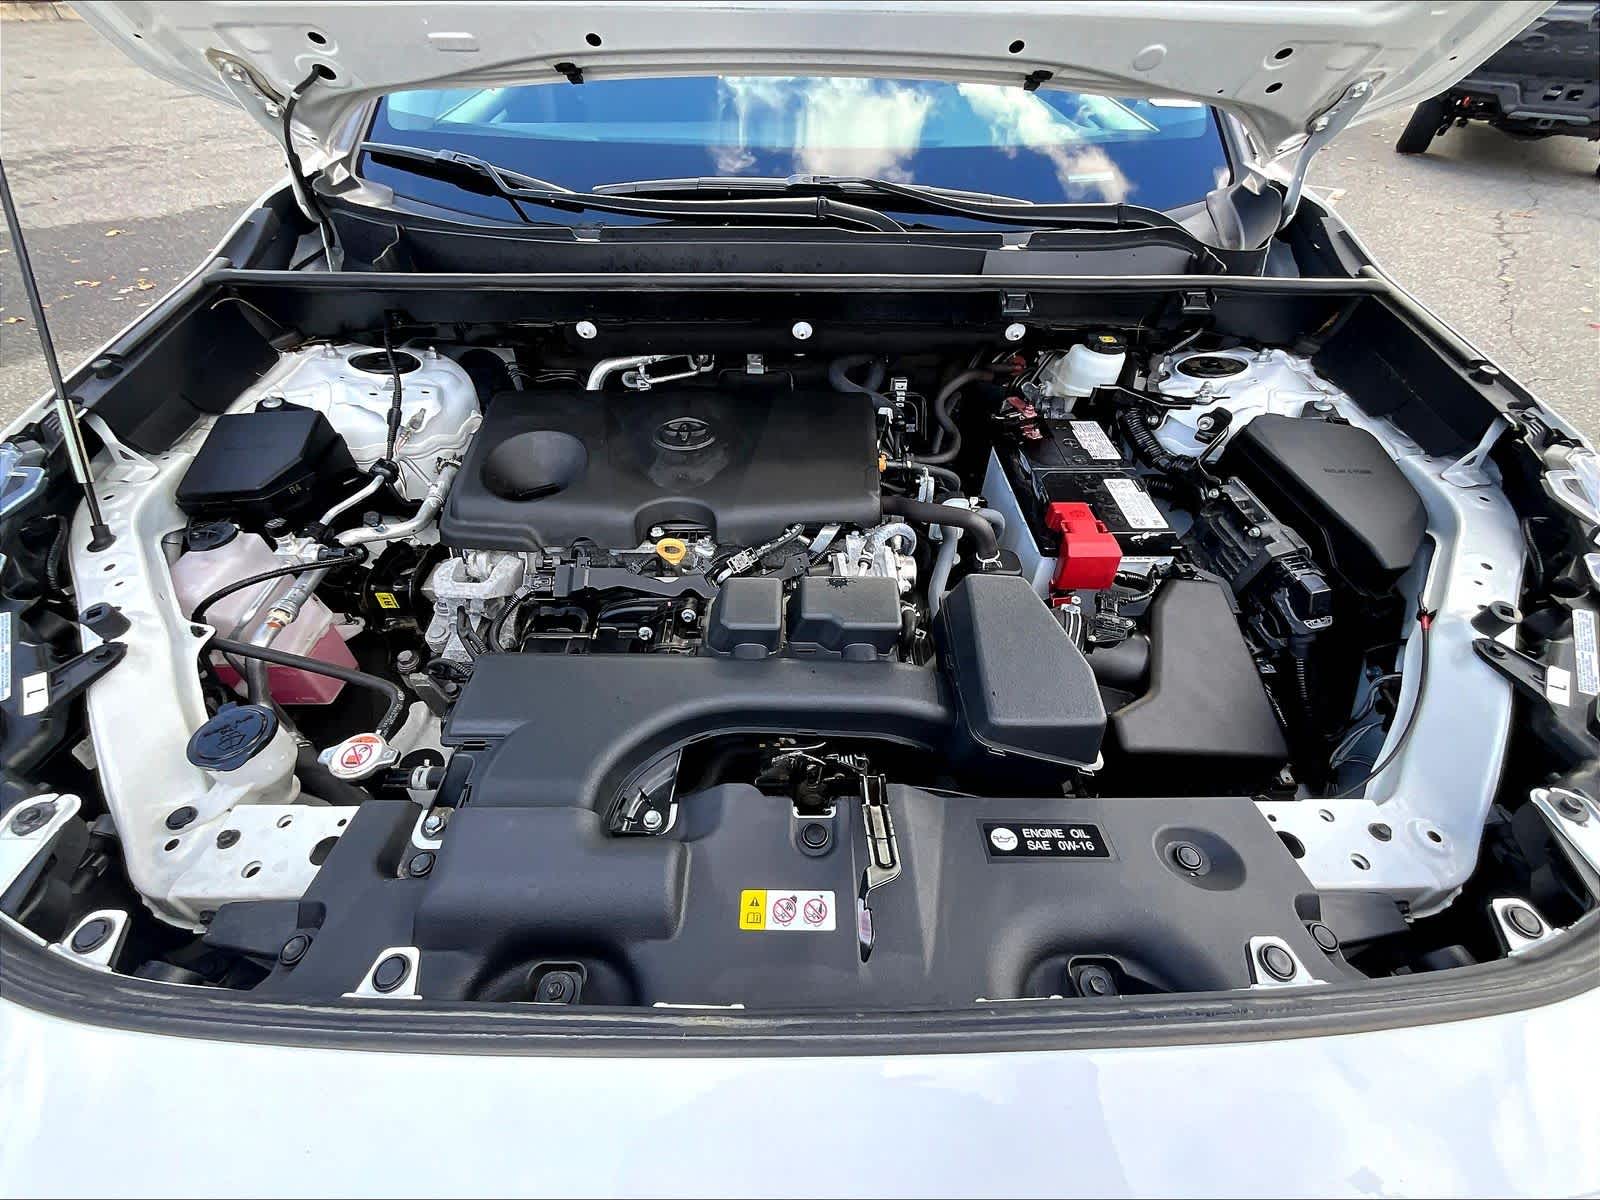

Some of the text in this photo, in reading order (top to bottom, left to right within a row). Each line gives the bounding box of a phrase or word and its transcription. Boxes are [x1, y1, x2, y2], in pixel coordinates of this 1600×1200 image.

[1022, 828, 1090, 839] ENGINE OIL
[1027, 840, 1095, 851] SAE 0W-16
